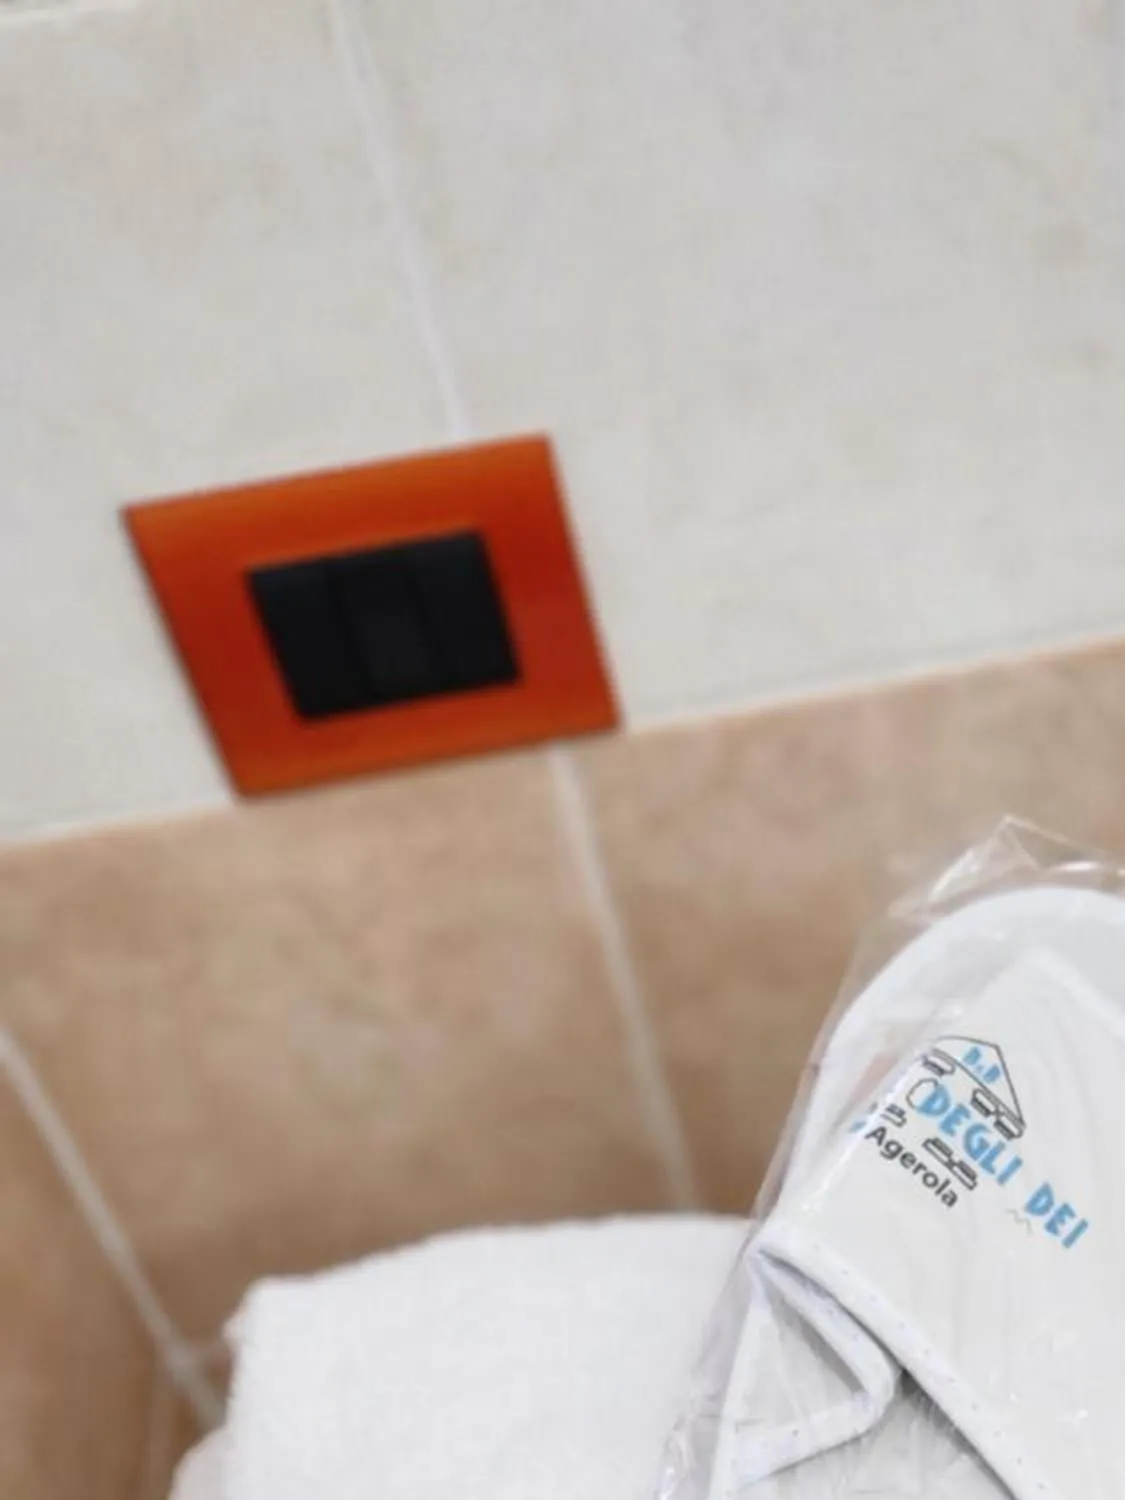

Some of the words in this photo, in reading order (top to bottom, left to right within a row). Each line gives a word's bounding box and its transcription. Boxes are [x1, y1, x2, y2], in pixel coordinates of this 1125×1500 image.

[865, 1126, 958, 1208] Agerola
[915, 1083, 1022, 1185] DEGLI
[1023, 1182, 1088, 1248] DEI
